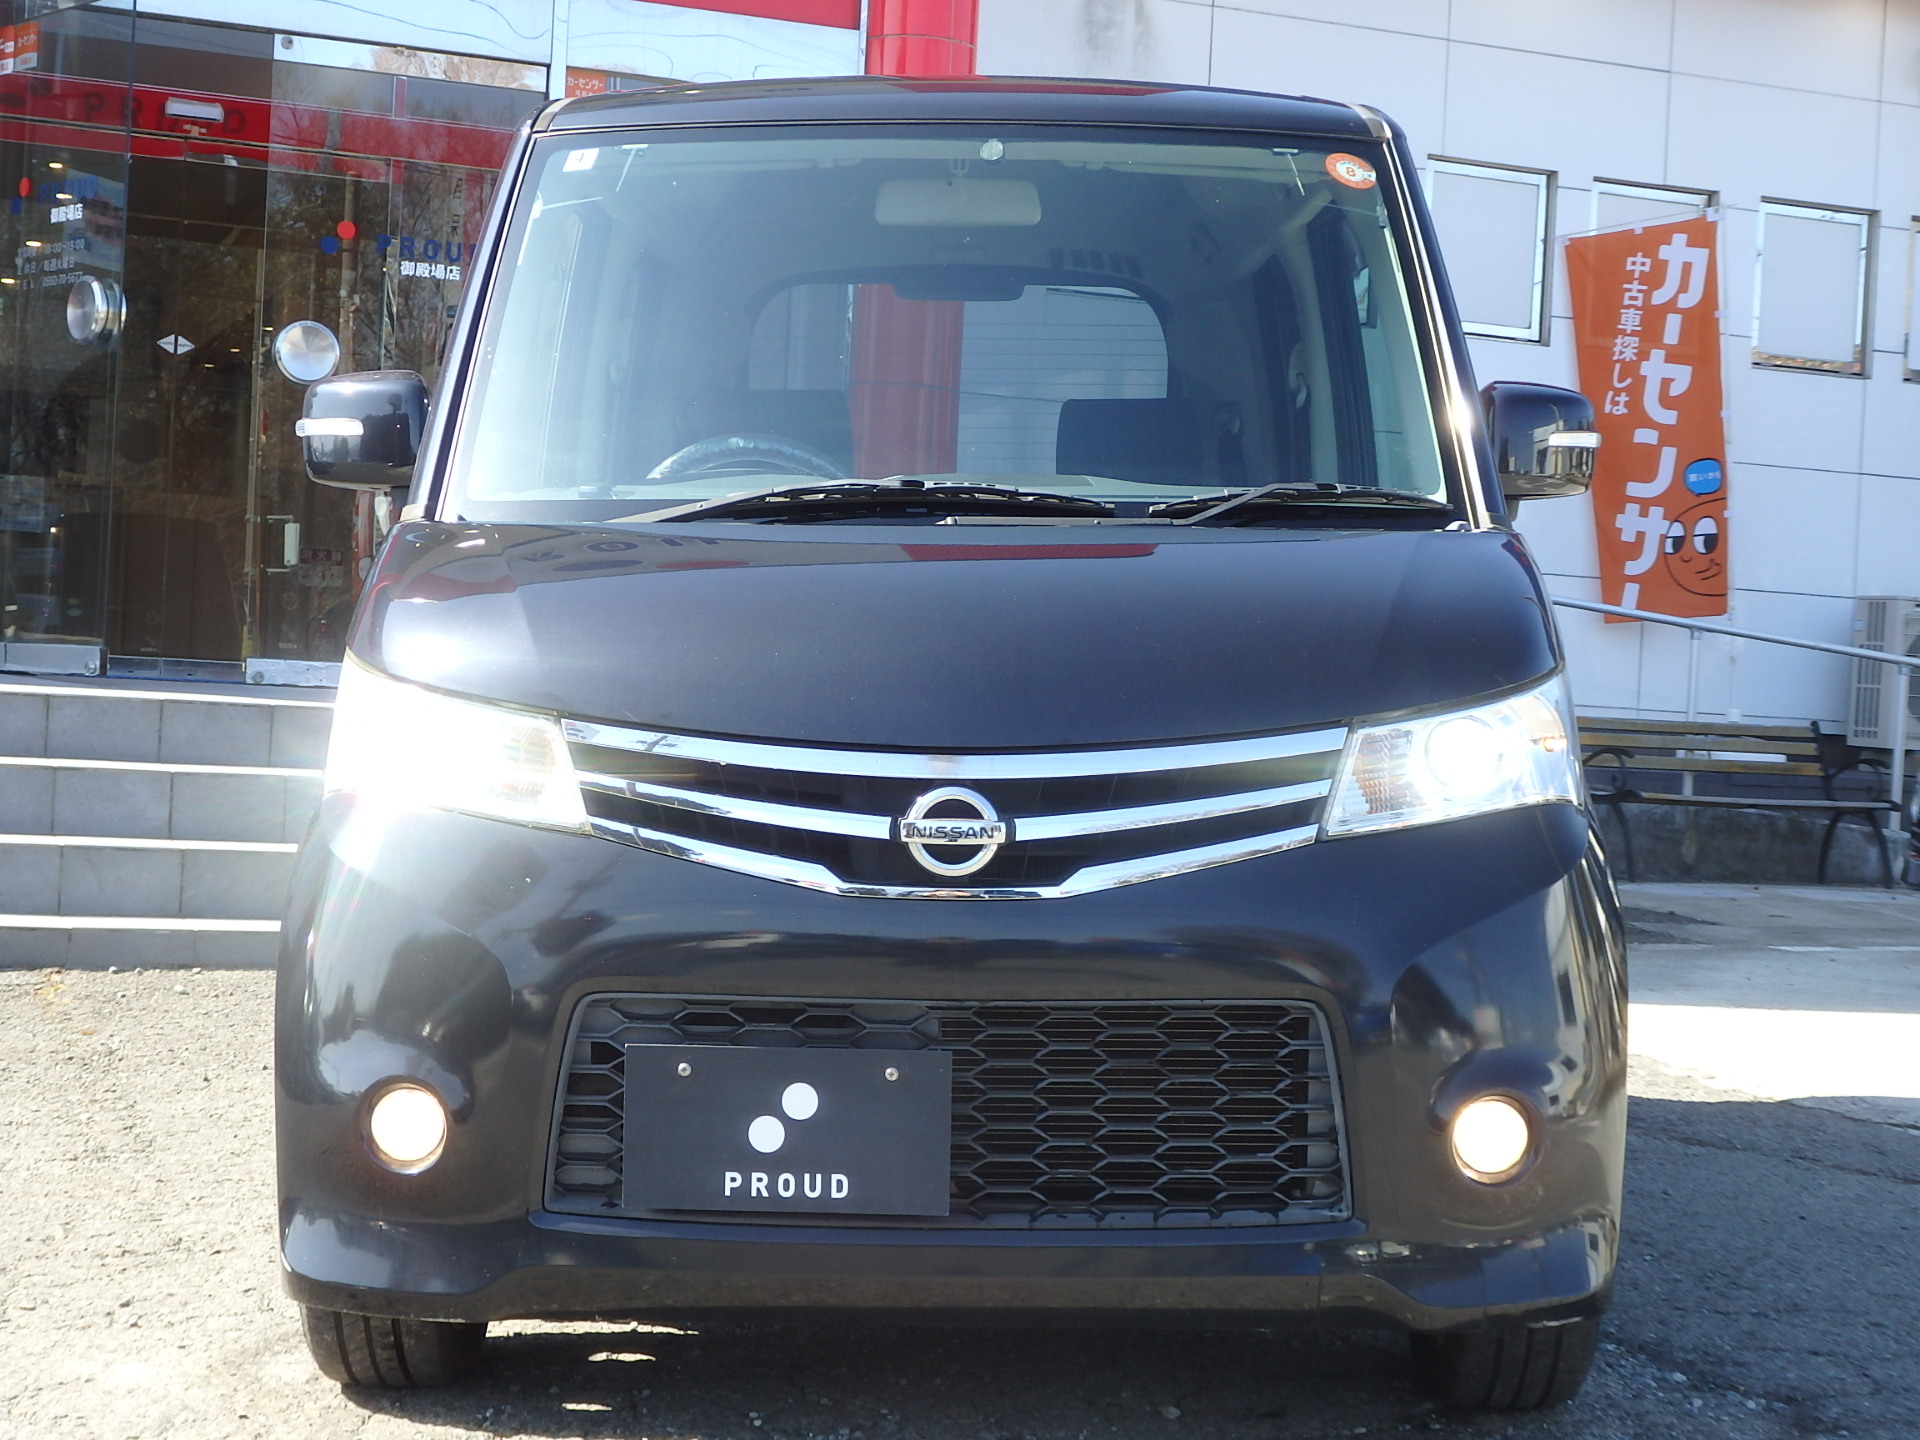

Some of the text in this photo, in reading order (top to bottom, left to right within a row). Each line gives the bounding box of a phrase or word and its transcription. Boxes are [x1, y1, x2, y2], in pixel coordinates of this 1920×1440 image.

[566, 76, 604, 90] カーセンサー
[400, 260, 461, 281] 御殿場店
[1603, 251, 1652, 416] 中古車探しは
[1614, 232, 1710, 610] カーセンサー
[912, 825, 995, 839] NISSAN
[723, 1171, 850, 1199] PROUD
